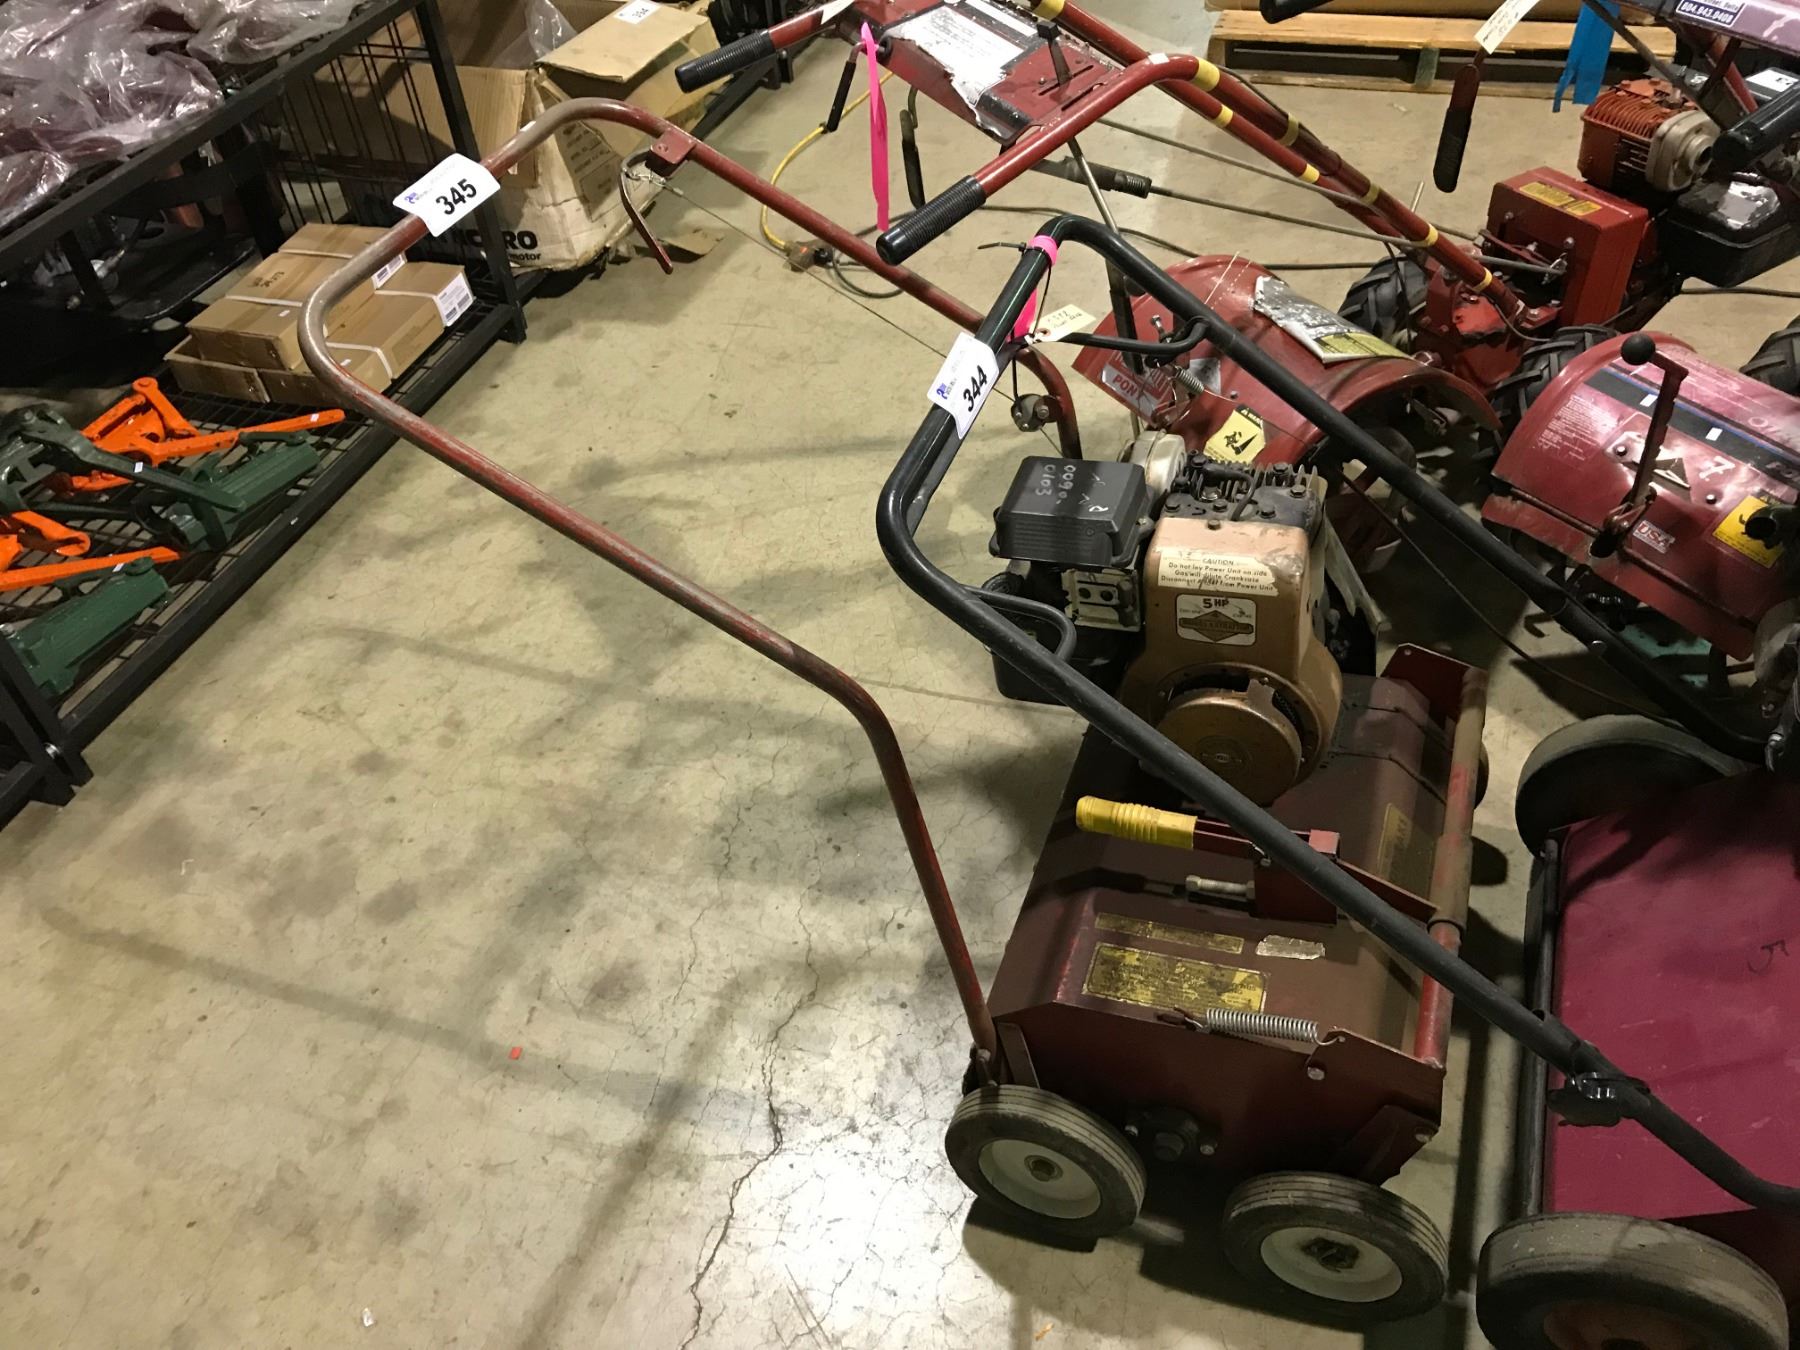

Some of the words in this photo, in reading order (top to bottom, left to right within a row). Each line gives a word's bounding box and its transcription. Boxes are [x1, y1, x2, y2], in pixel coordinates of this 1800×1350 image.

[435, 178, 477, 215] 345
[963, 364, 988, 413] 344
[1638, 523, 1670, 547] USA
[1202, 558, 1234, 566] CAUTION
[1174, 569, 1188, 577] Gas
[1204, 565, 1226, 573] Power
[1236, 582, 1258, 590] Power
[1202, 598, 1213, 609] 5
[1214, 598, 1230, 608] HP
